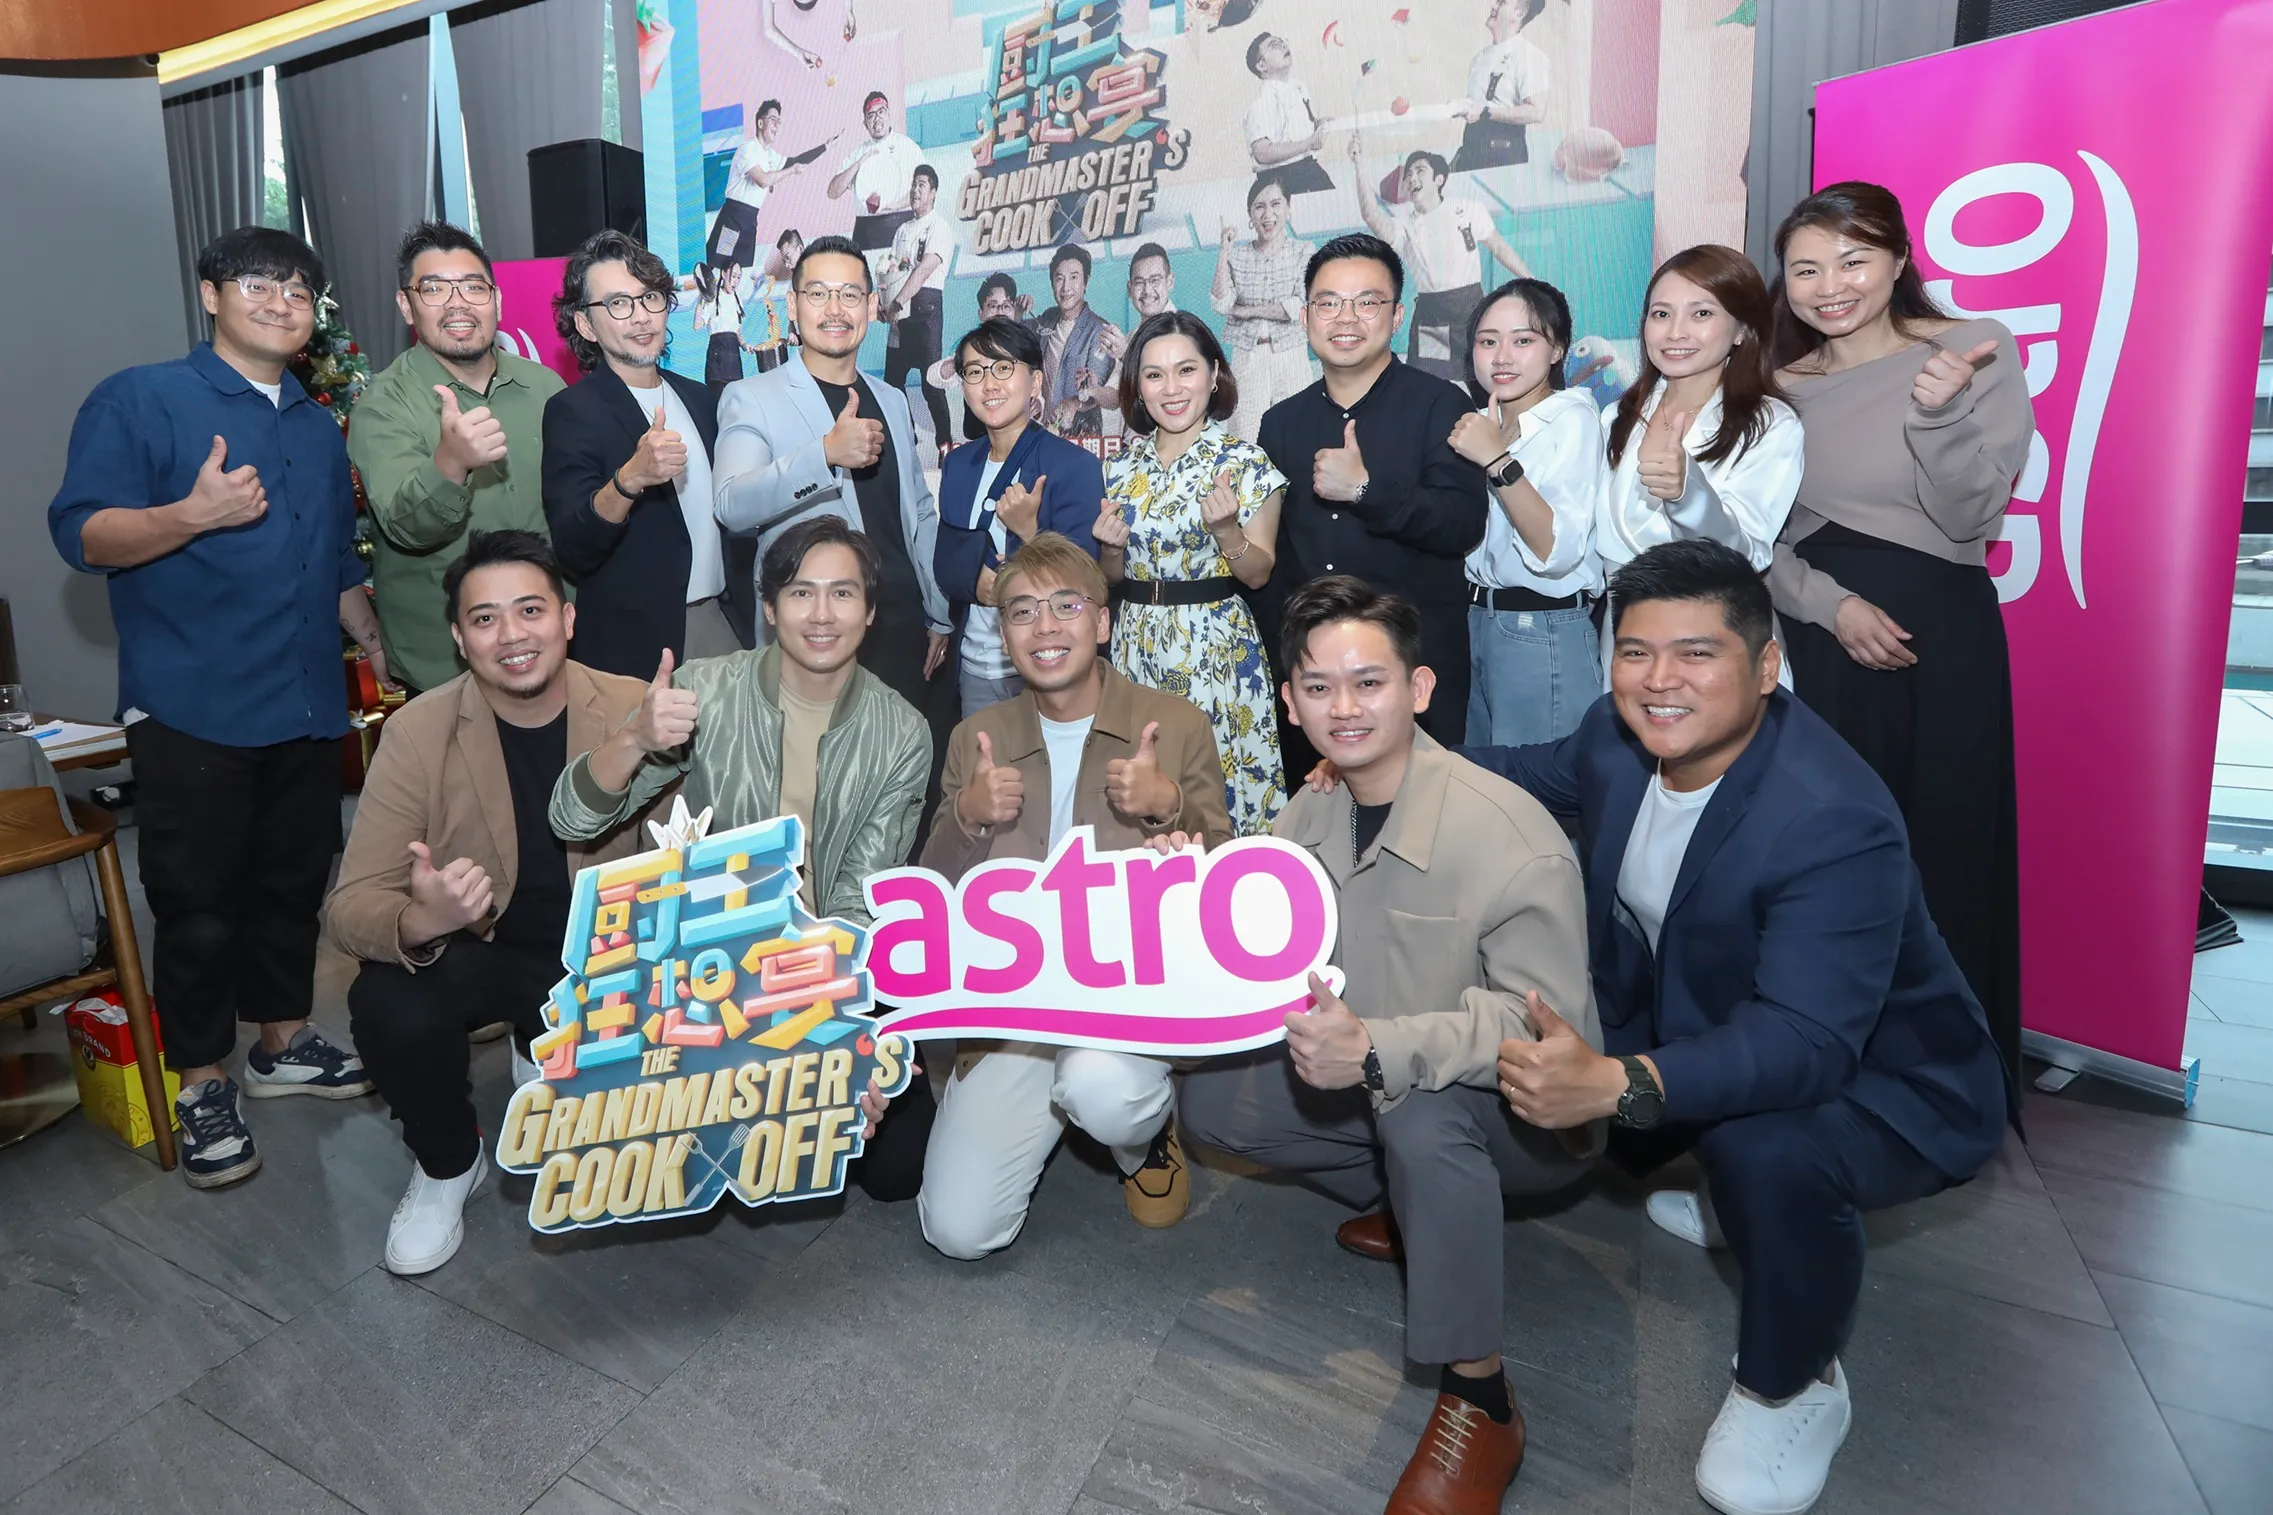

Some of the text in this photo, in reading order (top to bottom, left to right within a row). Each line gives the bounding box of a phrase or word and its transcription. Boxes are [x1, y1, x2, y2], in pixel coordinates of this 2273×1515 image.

[1027, 143, 1051, 164] THE
[974, 180, 1153, 255] COOK OFF
[869, 837, 1326, 995] astro
[84, 1033, 112, 1058] BRAND
[640, 1046, 682, 1076] THE
[531, 1106, 856, 1228] COOK OFF
